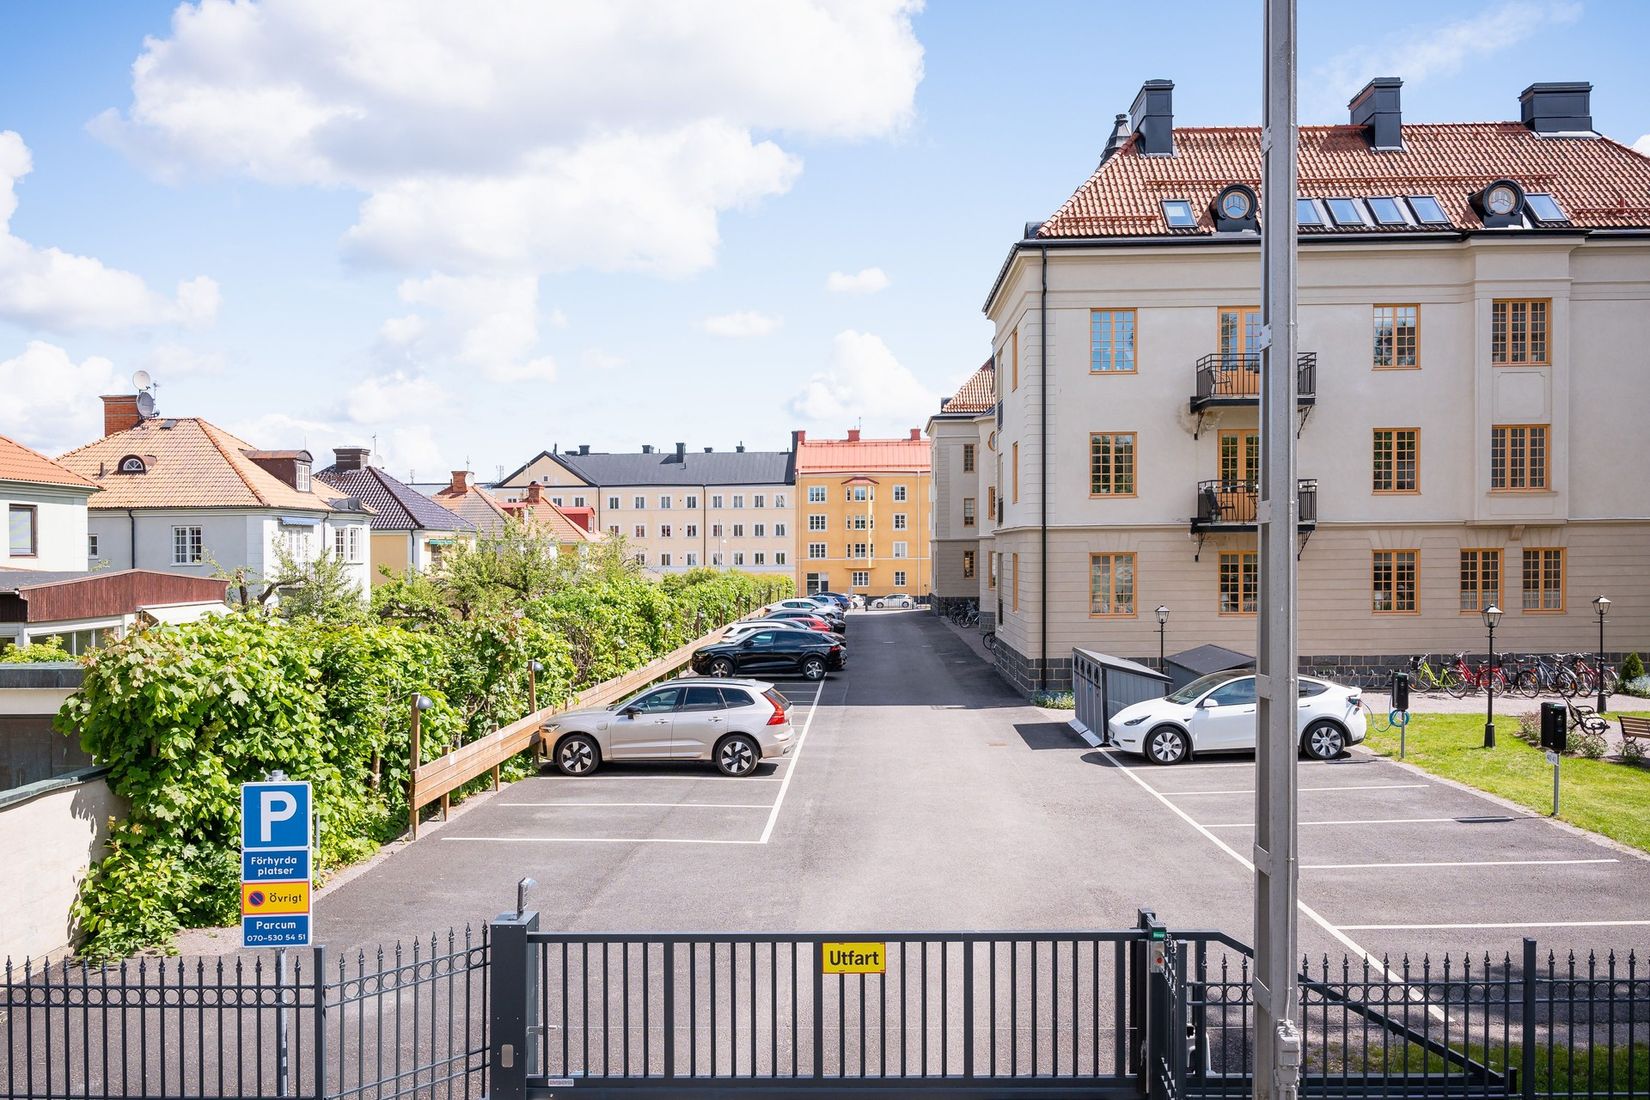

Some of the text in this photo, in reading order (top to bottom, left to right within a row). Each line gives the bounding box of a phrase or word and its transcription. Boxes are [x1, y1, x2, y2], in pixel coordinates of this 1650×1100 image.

[260, 790, 297, 842] P
[251, 856, 297, 866] Förhyrda
[257, 867, 294, 877] platser
[269, 892, 302, 904] Övrigt
[256, 920, 296, 930] Parcum
[246, 933, 306, 942] 070-530 54 51
[829, 950, 880, 966] Utfart
